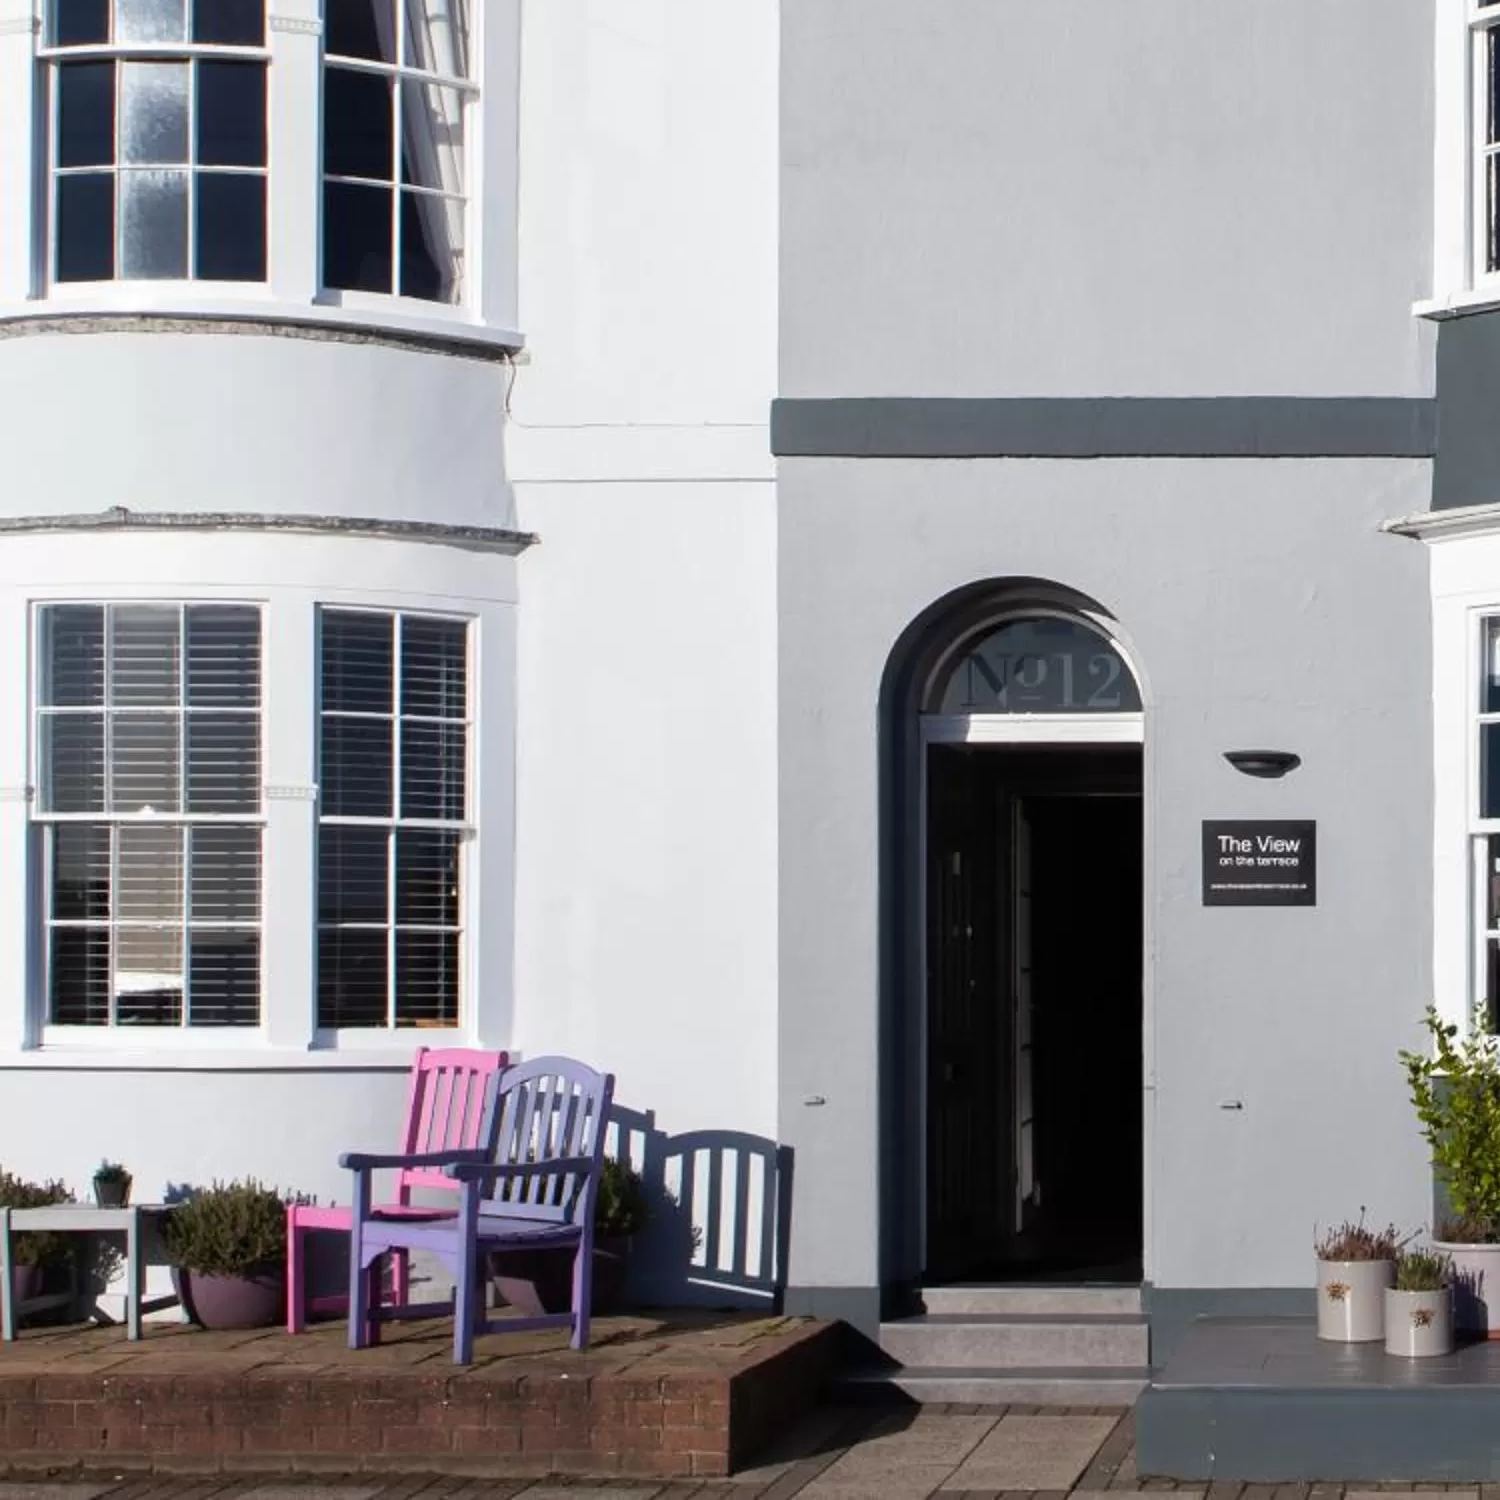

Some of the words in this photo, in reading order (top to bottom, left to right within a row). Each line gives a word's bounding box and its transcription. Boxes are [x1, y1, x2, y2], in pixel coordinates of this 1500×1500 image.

[1217, 835, 1253, 853] The
[1255, 835, 1301, 853] View
[1219, 856, 1233, 867] on
[1235, 854, 1254, 867] the
[1257, 855, 1299, 867] terrace
